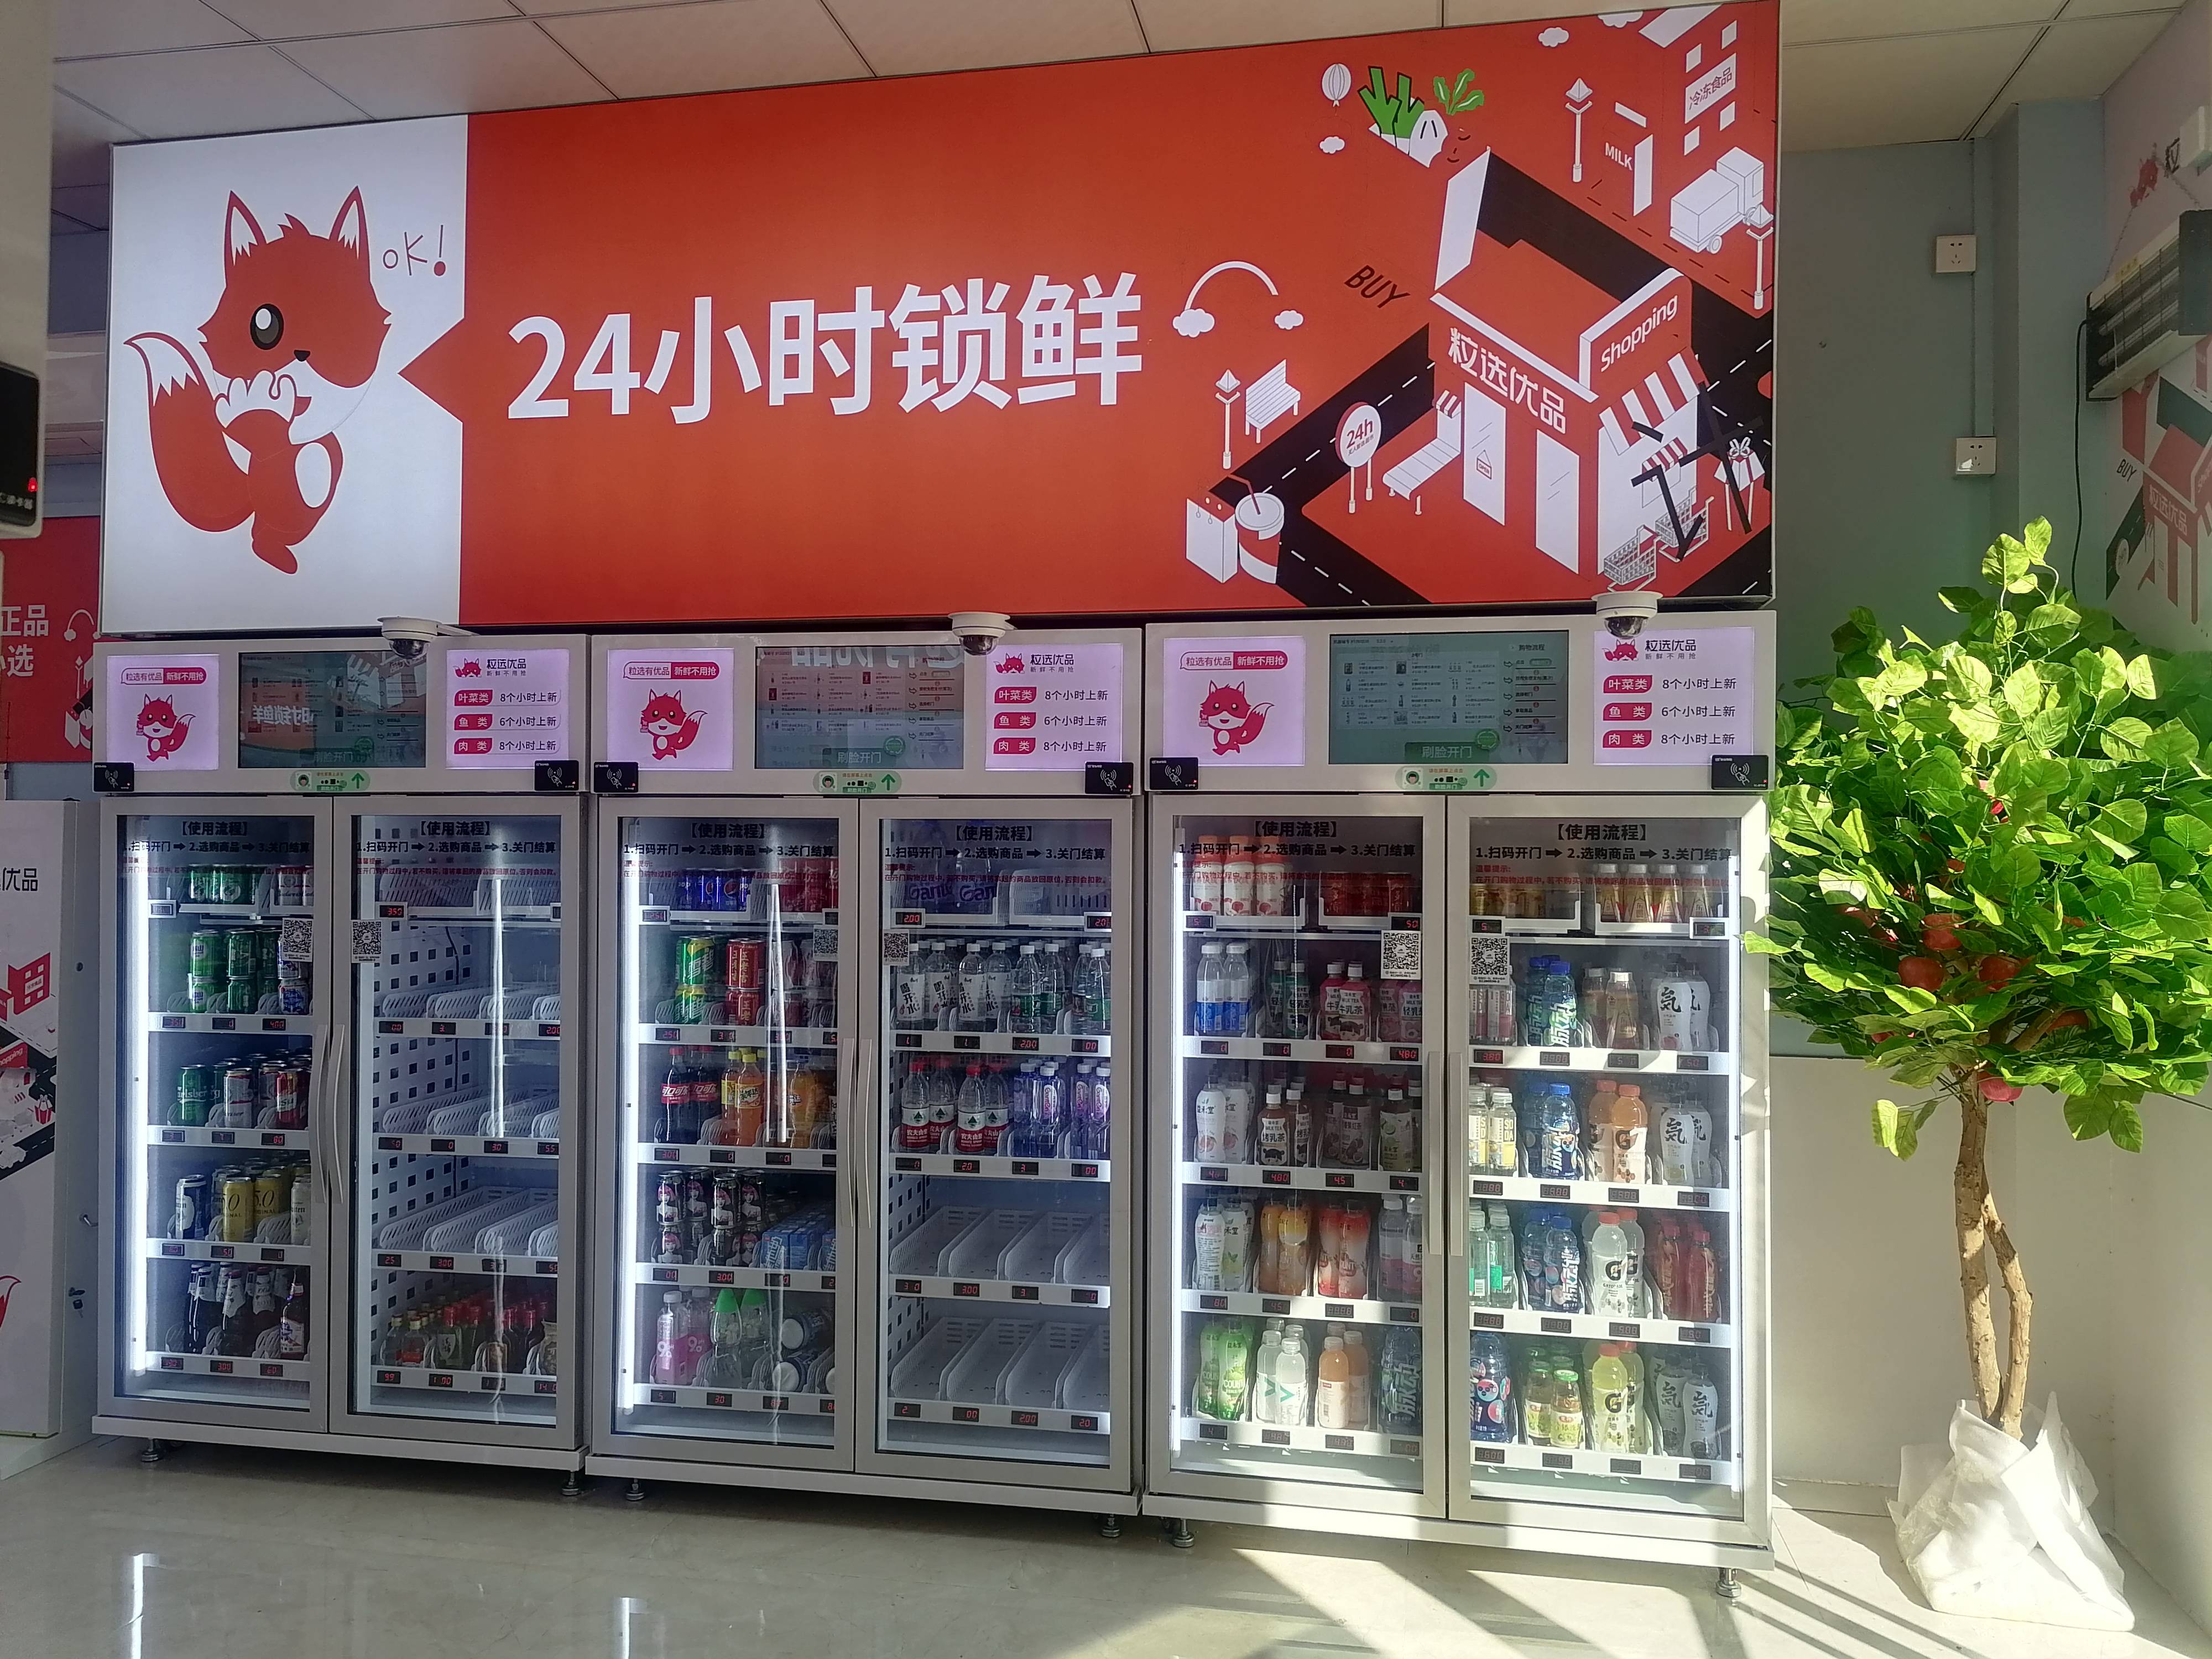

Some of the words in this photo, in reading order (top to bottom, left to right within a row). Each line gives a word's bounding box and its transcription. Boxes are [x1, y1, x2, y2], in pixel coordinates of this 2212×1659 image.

[1688, 66, 1733, 111] 冷冻食品
[1604, 142, 1633, 171] MILK
[1344, 264, 1410, 310] BUY
[508, 272, 1142, 424] 24小时锁鲜
[1448, 327, 1567, 434] 粒选优品
[1346, 419, 1373, 450] 24h
[2116, 458, 2137, 482] BUY
[1645, 639, 1697, 652] 粒选优品
[487, 658, 526, 670] 粒选优品
[1030, 654, 1074, 665] 粒选优品
[1186, 656, 1232, 667] 粒选有优品
[1237, 656, 1285, 666] 新鲜不用抢
[126, 672, 163, 682] 粒选有优品
[166, 671, 204, 681] 新鲜不用抢
[629, 666, 670, 676] 粒选有优品
[674, 666, 717, 676] 新鲜不用抢
[1608, 679, 1647, 691] 叶菜类
[1662, 678, 1737, 690] 8个小时上新
[458, 693, 489, 703] 叶菜类
[500, 692, 557, 703] 8个小时上新
[999, 690, 1032, 701] 叶菜类
[1045, 690, 1108, 701] 8个小时上新
[1661, 706, 1736, 718] 6个小时上新
[499, 716, 557, 727] 6个小时上新
[1044, 715, 1107, 727] 6个小时上新
[1661, 733, 1735, 745] 8个小时上新
[499, 740, 556, 752] 8个小时上新
[1044, 740, 1107, 752] 8个小时上新
[1422, 745, 1472, 759] 刷脸开门
[837, 751, 881, 764] 刷脸开门
[189, 841, 240, 853] 2.选购商品
[258, 842, 310, 854] 3.关门结算
[357, 841, 409, 853] 1.扫码开门
[429, 841, 482, 853] 2.选购商品
[502, 841, 556, 854] 3.关门结算
[699, 844, 756, 856] 2.选购商品
[777, 844, 834, 857] 3.关门结算
[884, 846, 943, 859] 1.扫码开门
[964, 847, 1023, 860] 2.选购商品
[1045, 847, 1105, 860] 3.关门结算
[1179, 842, 1240, 856] 1.扫码开门
[1264, 843, 1327, 857] 2.选购商品
[1350, 843, 1416, 857] 3.关门结算
[1475, 846, 1542, 860] 1.扫码开门
[1567, 847, 1636, 860] 2.选购商品
[1662, 847, 1732, 862] 3.关门结算
